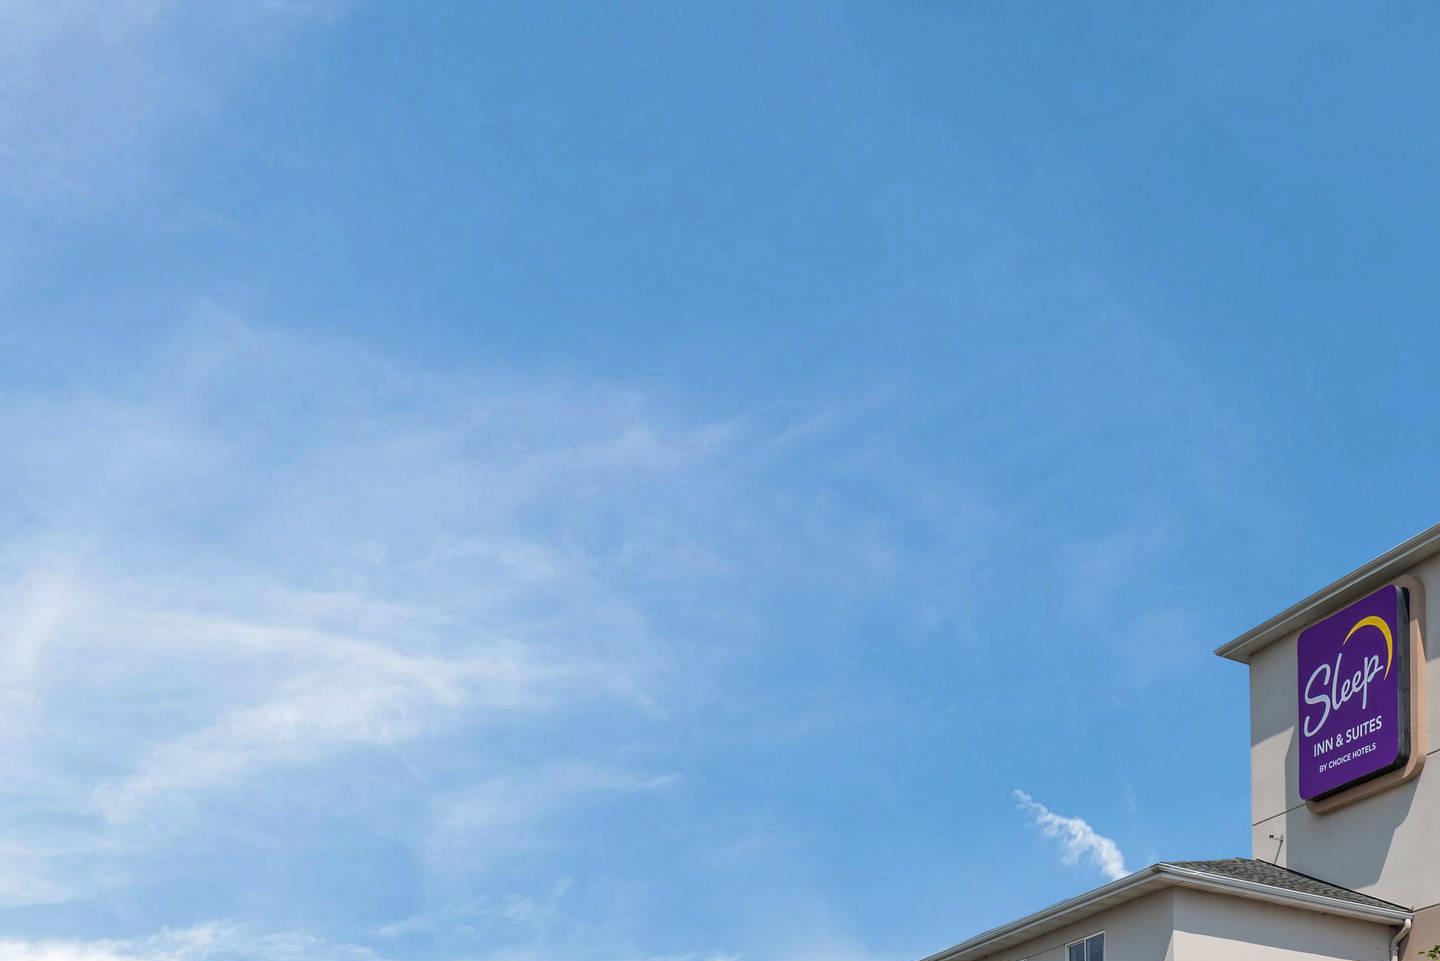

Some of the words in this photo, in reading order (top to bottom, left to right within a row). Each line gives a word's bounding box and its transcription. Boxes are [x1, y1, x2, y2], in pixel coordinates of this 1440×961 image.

[1303, 652, 1384, 738] Sleep
[1313, 737, 1334, 757] INN
[1335, 733, 1344, 747] &
[1345, 715, 1383, 744] SUITES
[1319, 762, 1328, 773] BY
[1328, 752, 1352, 769] CHOICE
[1352, 742, 1377, 760] HOTELS
